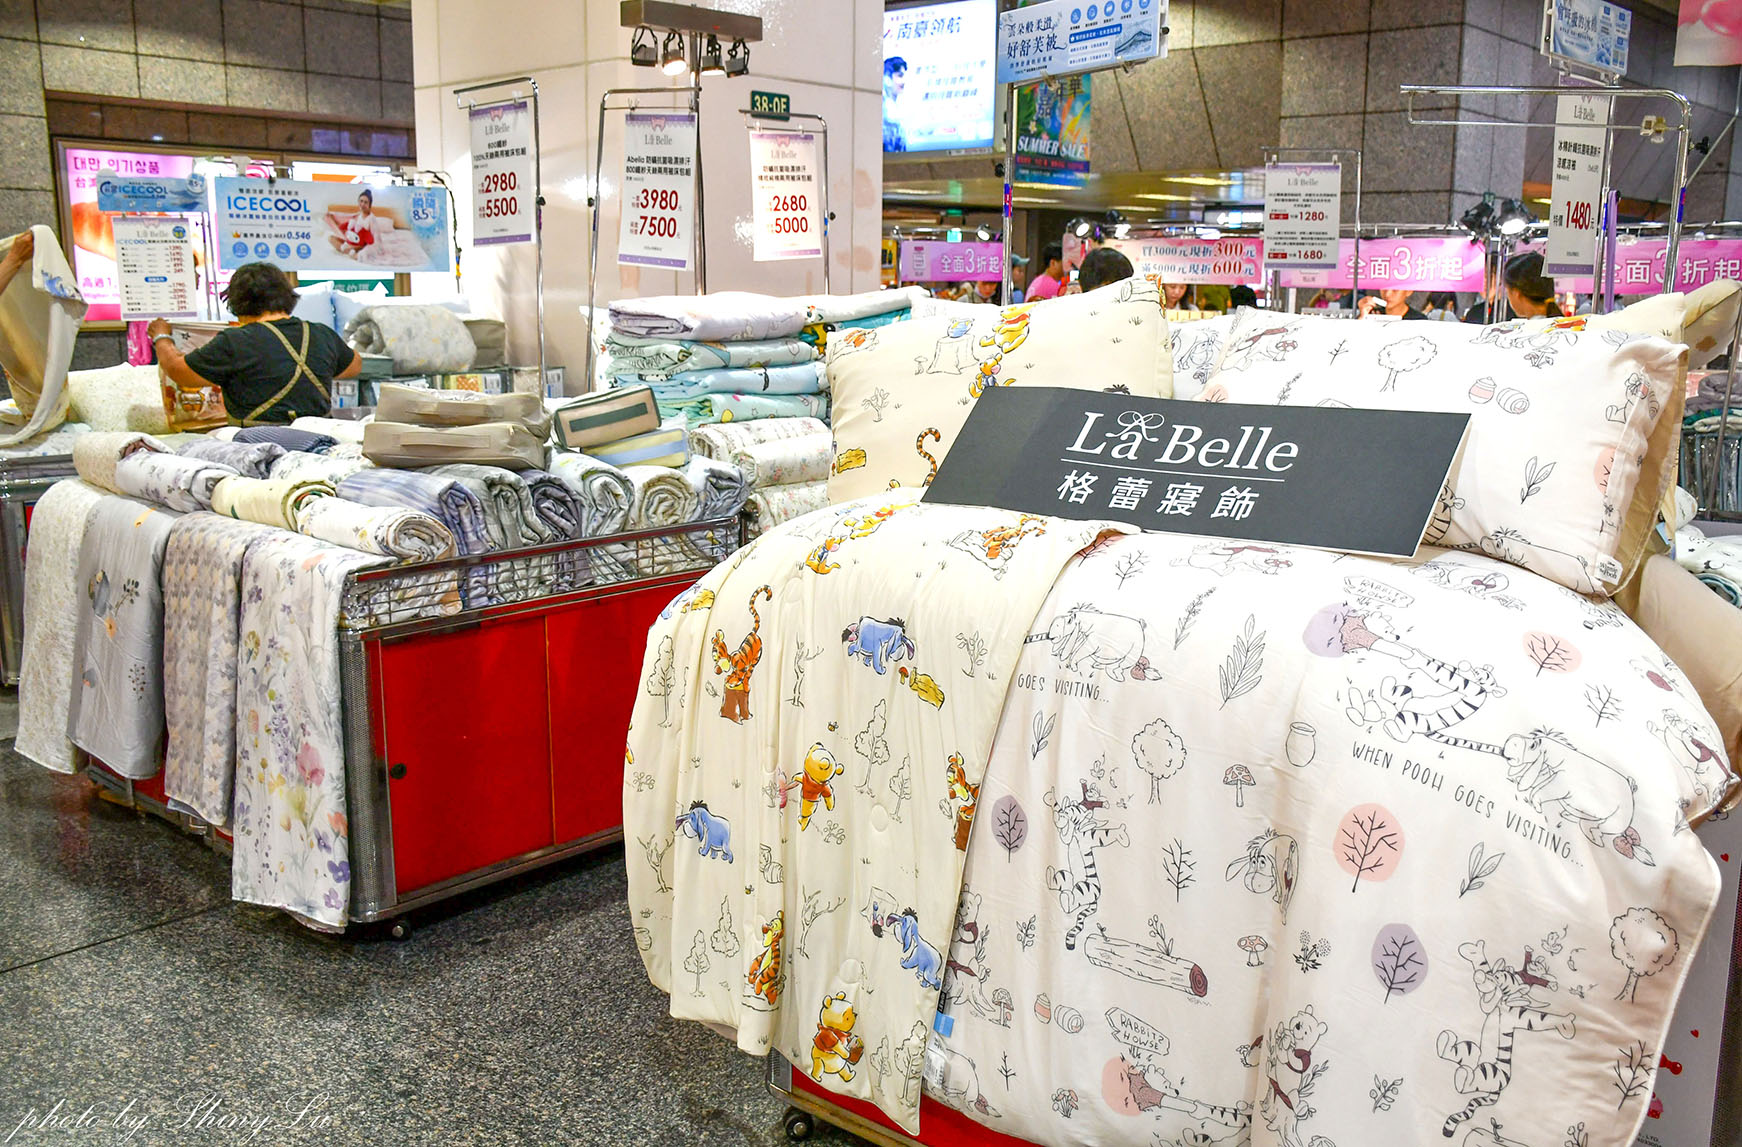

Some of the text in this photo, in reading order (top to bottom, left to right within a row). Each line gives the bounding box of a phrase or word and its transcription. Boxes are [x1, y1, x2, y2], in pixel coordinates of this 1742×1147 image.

[1583, 106, 1595, 122] Belle
[494, 123, 510, 135] Belle
[655, 135, 673, 146] Belle
[1017, 135, 1086, 158] SUMMER SALE
[73, 156, 160, 175] 대만 인기상품
[484, 171, 517, 194] 2980
[1300, 178, 1319, 186] Belle
[227, 195, 311, 214] ICECOOL
[485, 196, 517, 218] 5500
[640, 188, 679, 211] 3980
[773, 195, 807, 212] 2680
[639, 215, 677, 238] 7500
[775, 216, 808, 234] 5000
[1299, 211, 1325, 221] 1280
[1565, 201, 1591, 231] 1480
[287, 232, 311, 241] 0.546
[941, 248, 1000, 274] 全面3折起
[1297, 250, 1323, 260] 1680
[1346, 246, 1464, 281] 全面3折起
[1065, 411, 1298, 473] La Belle
[1057, 469, 1259, 523] 格蕾寢飾
[1016, 673, 1046, 694] GOES
[1351, 740, 1391, 777] WHEN
[1401, 755, 1442, 793] POOH
[1454, 784, 1495, 820] GOES
